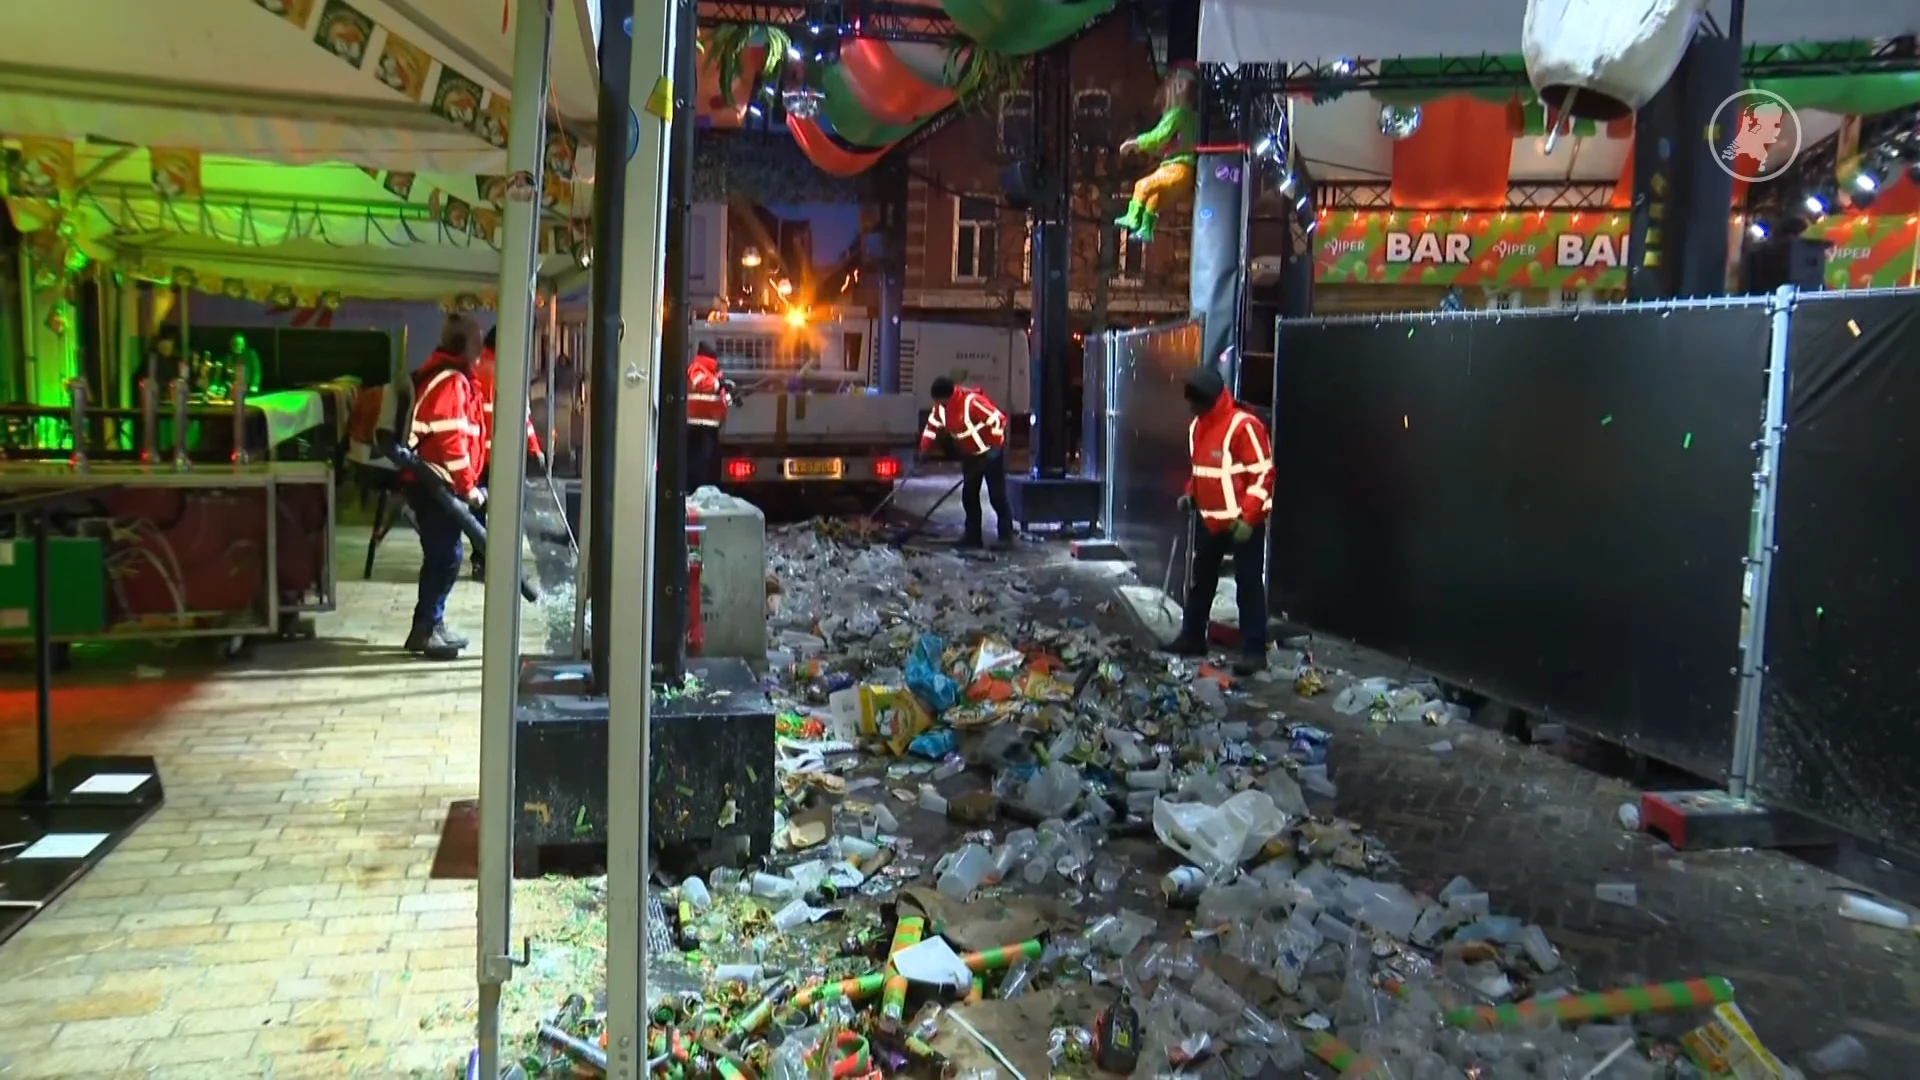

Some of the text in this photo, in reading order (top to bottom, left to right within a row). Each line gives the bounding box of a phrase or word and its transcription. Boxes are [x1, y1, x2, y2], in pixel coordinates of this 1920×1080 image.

[1325, 238, 1365, 255] VIPER
[1387, 232, 1470, 263] BAR
[1493, 240, 1536, 258] VIPER
